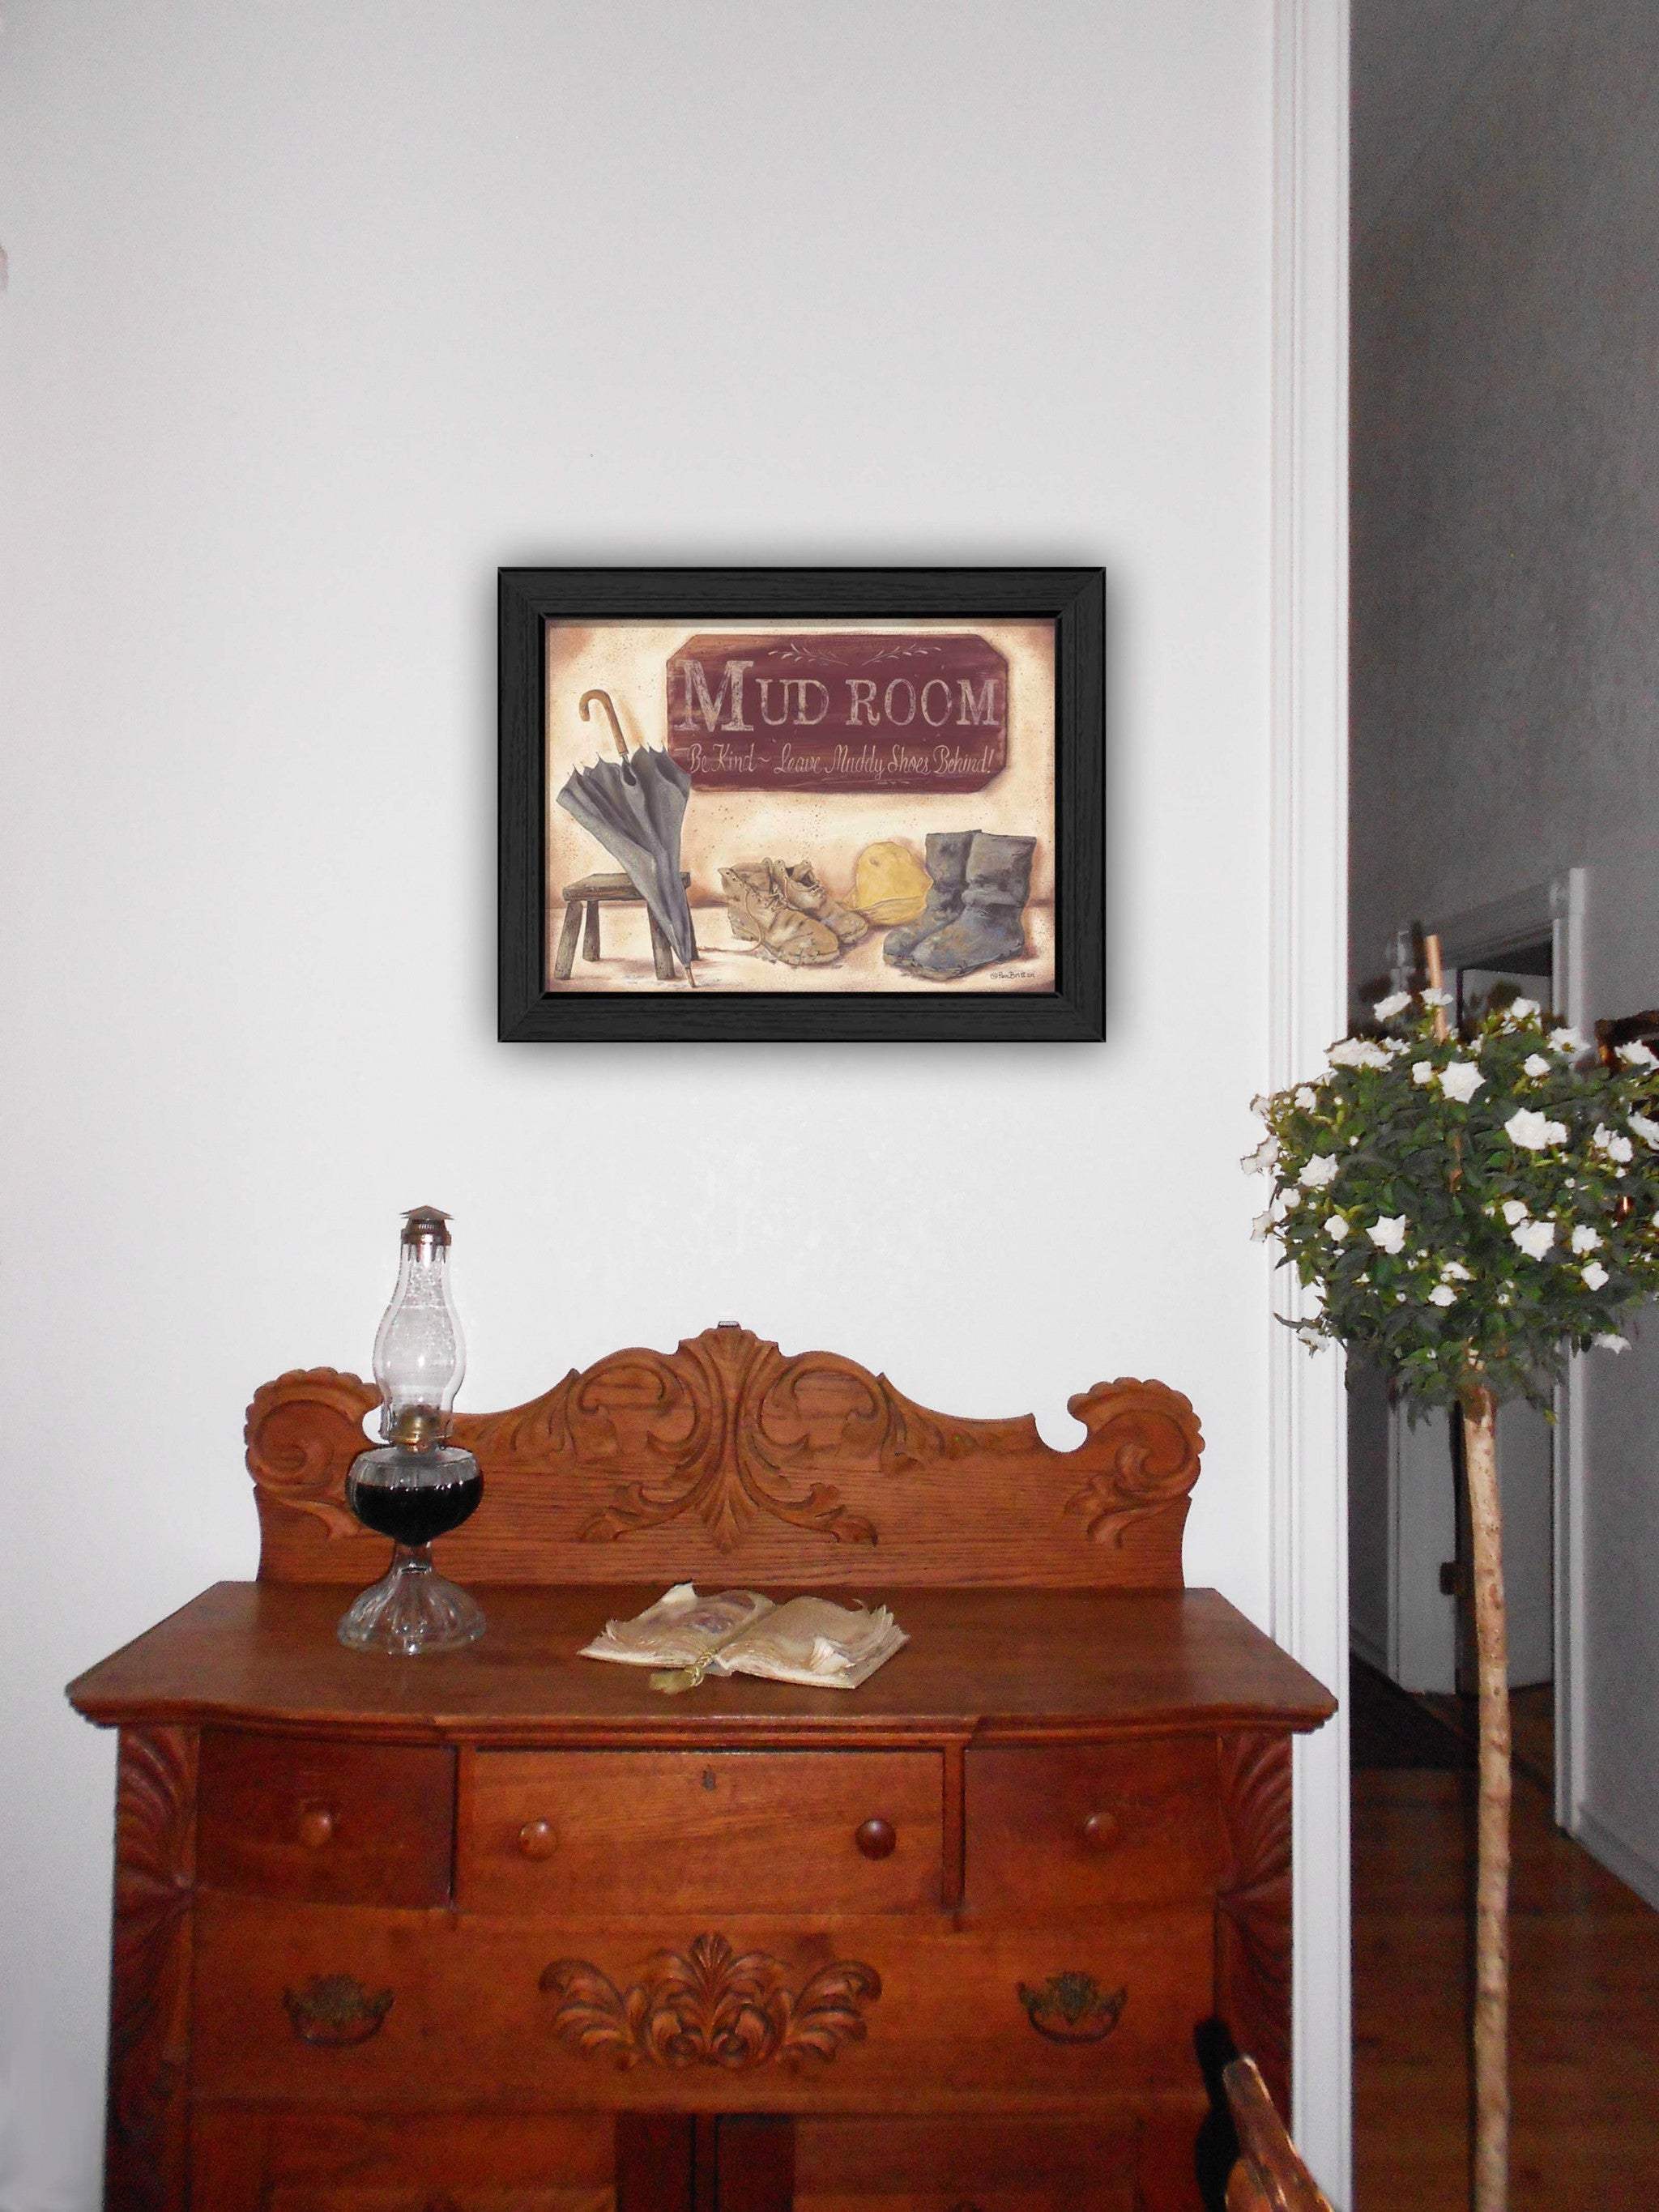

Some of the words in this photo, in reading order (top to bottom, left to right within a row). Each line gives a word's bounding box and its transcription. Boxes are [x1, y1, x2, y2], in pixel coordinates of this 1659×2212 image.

[674, 659, 830, 732] MUD
[845, 678, 1000, 727] ROOM
[689, 743, 708, 774] Be
[774, 743, 821, 774] Leave
[825, 744, 885, 780] Muddy
[887, 744, 932, 775] Shoes
[932, 744, 995, 774] Behind!
